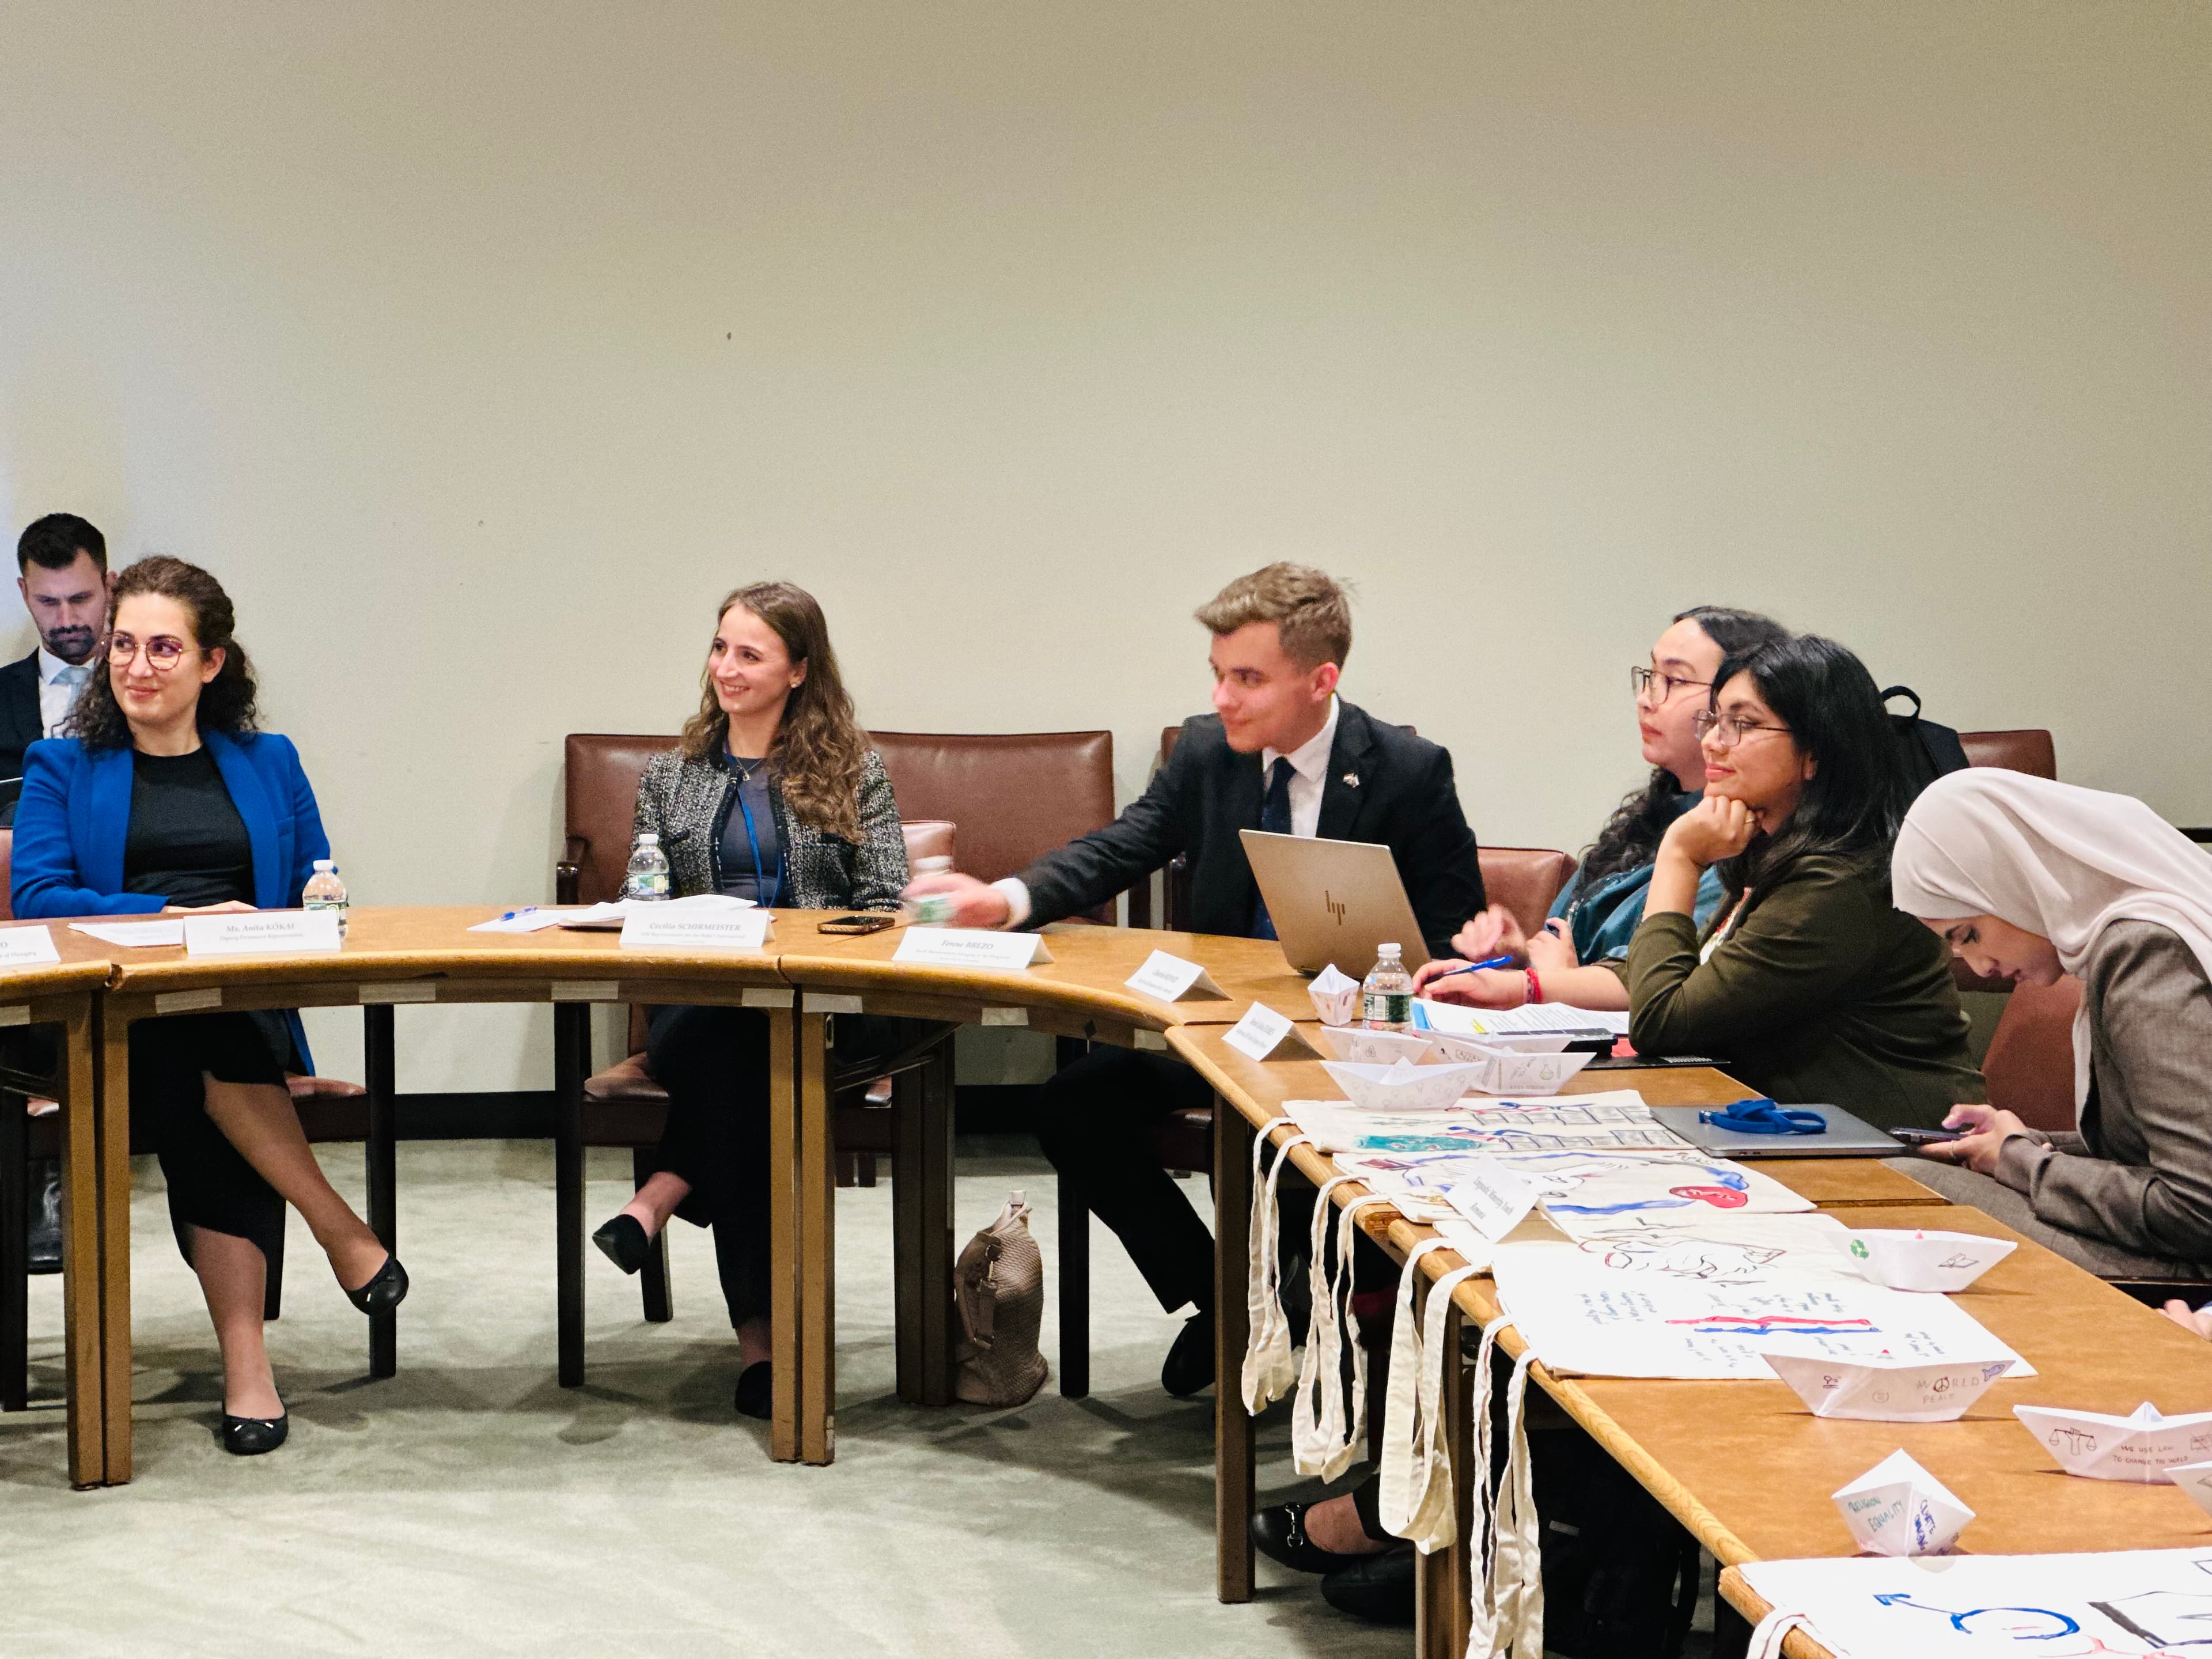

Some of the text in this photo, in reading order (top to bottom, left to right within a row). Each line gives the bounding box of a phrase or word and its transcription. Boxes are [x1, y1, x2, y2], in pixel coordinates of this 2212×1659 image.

[1325, 890, 1346, 926] hp
[649, 922, 742, 931] Cecilia SCHIRMEISTER
[1923, 1392, 1955, 1404] PEACE
[2113, 1455, 2122, 1463] TO
[2125, 1457, 2152, 1465] CHANGE
[2169, 1456, 2188, 1464] WORLD
[1848, 1497, 1881, 1513] RELIGION
[1868, 1500, 1906, 1532] EQUALITY
